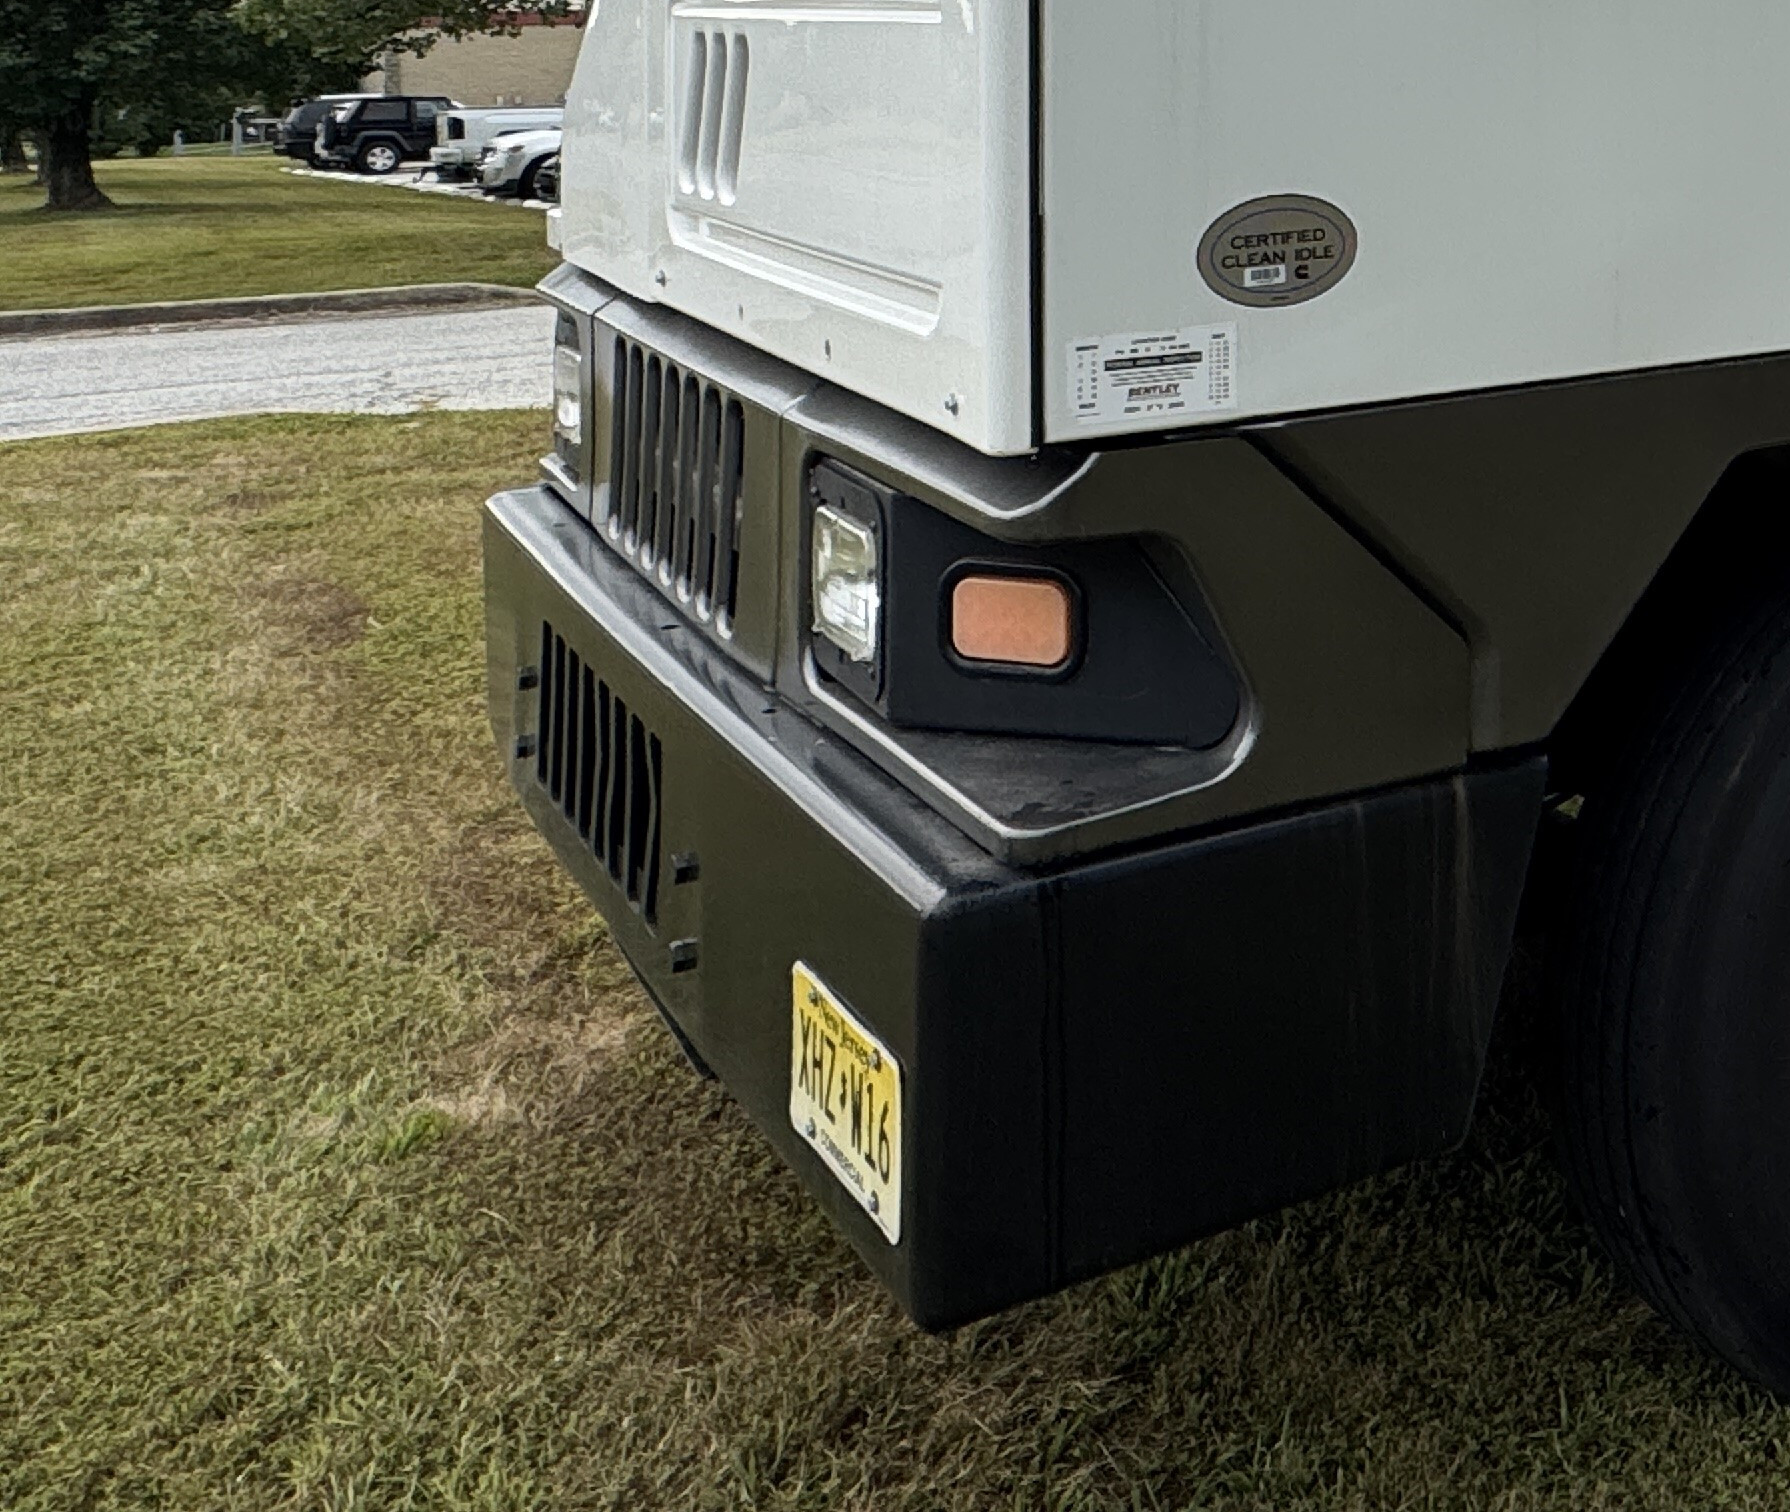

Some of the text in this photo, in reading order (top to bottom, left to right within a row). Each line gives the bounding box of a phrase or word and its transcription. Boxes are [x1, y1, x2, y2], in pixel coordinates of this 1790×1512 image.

[1230, 228, 1326, 250] CERTIFIED
[1221, 244, 1335, 269] CLEAN IDLE
[1128, 382, 1180, 398] BENTLEY
[818, 994, 870, 1075] New Jersey
